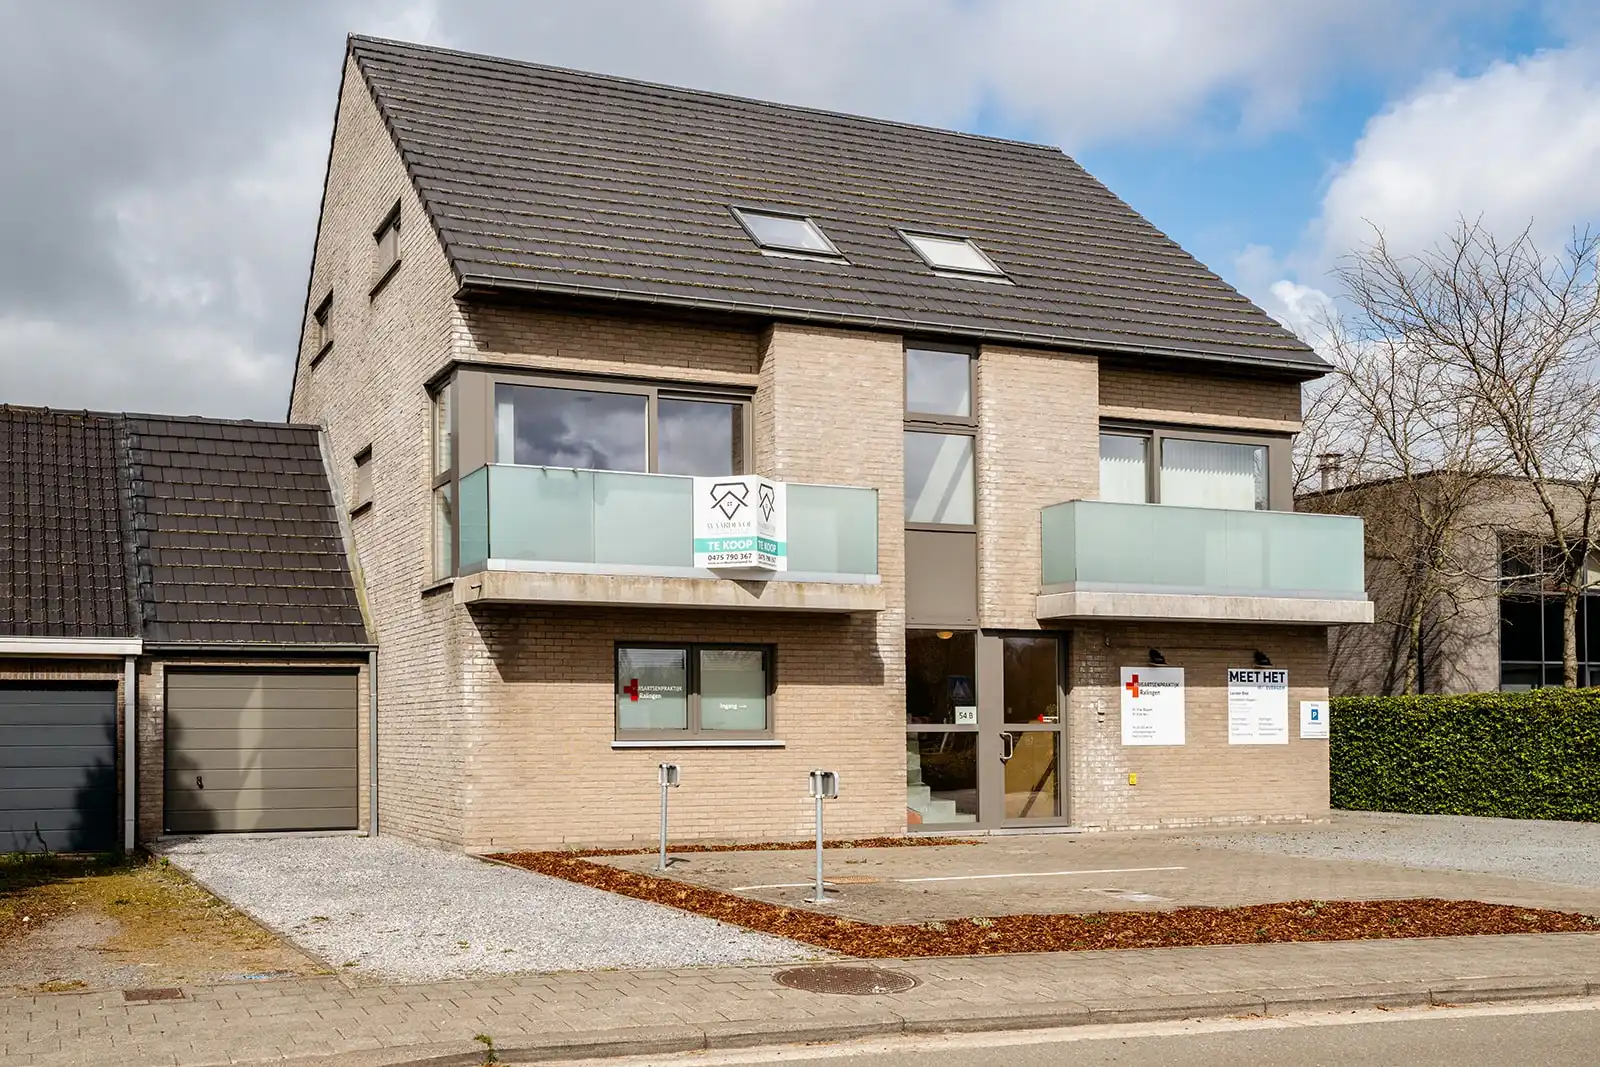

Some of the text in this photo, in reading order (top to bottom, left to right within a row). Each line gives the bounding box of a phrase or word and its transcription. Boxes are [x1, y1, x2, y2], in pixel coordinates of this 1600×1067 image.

[707, 539, 753, 551] TE KOOP
[758, 540, 777, 553] TE KOOP
[1229, 670, 1286, 683] MEET HET
[959, 712, 968, 720] 54
